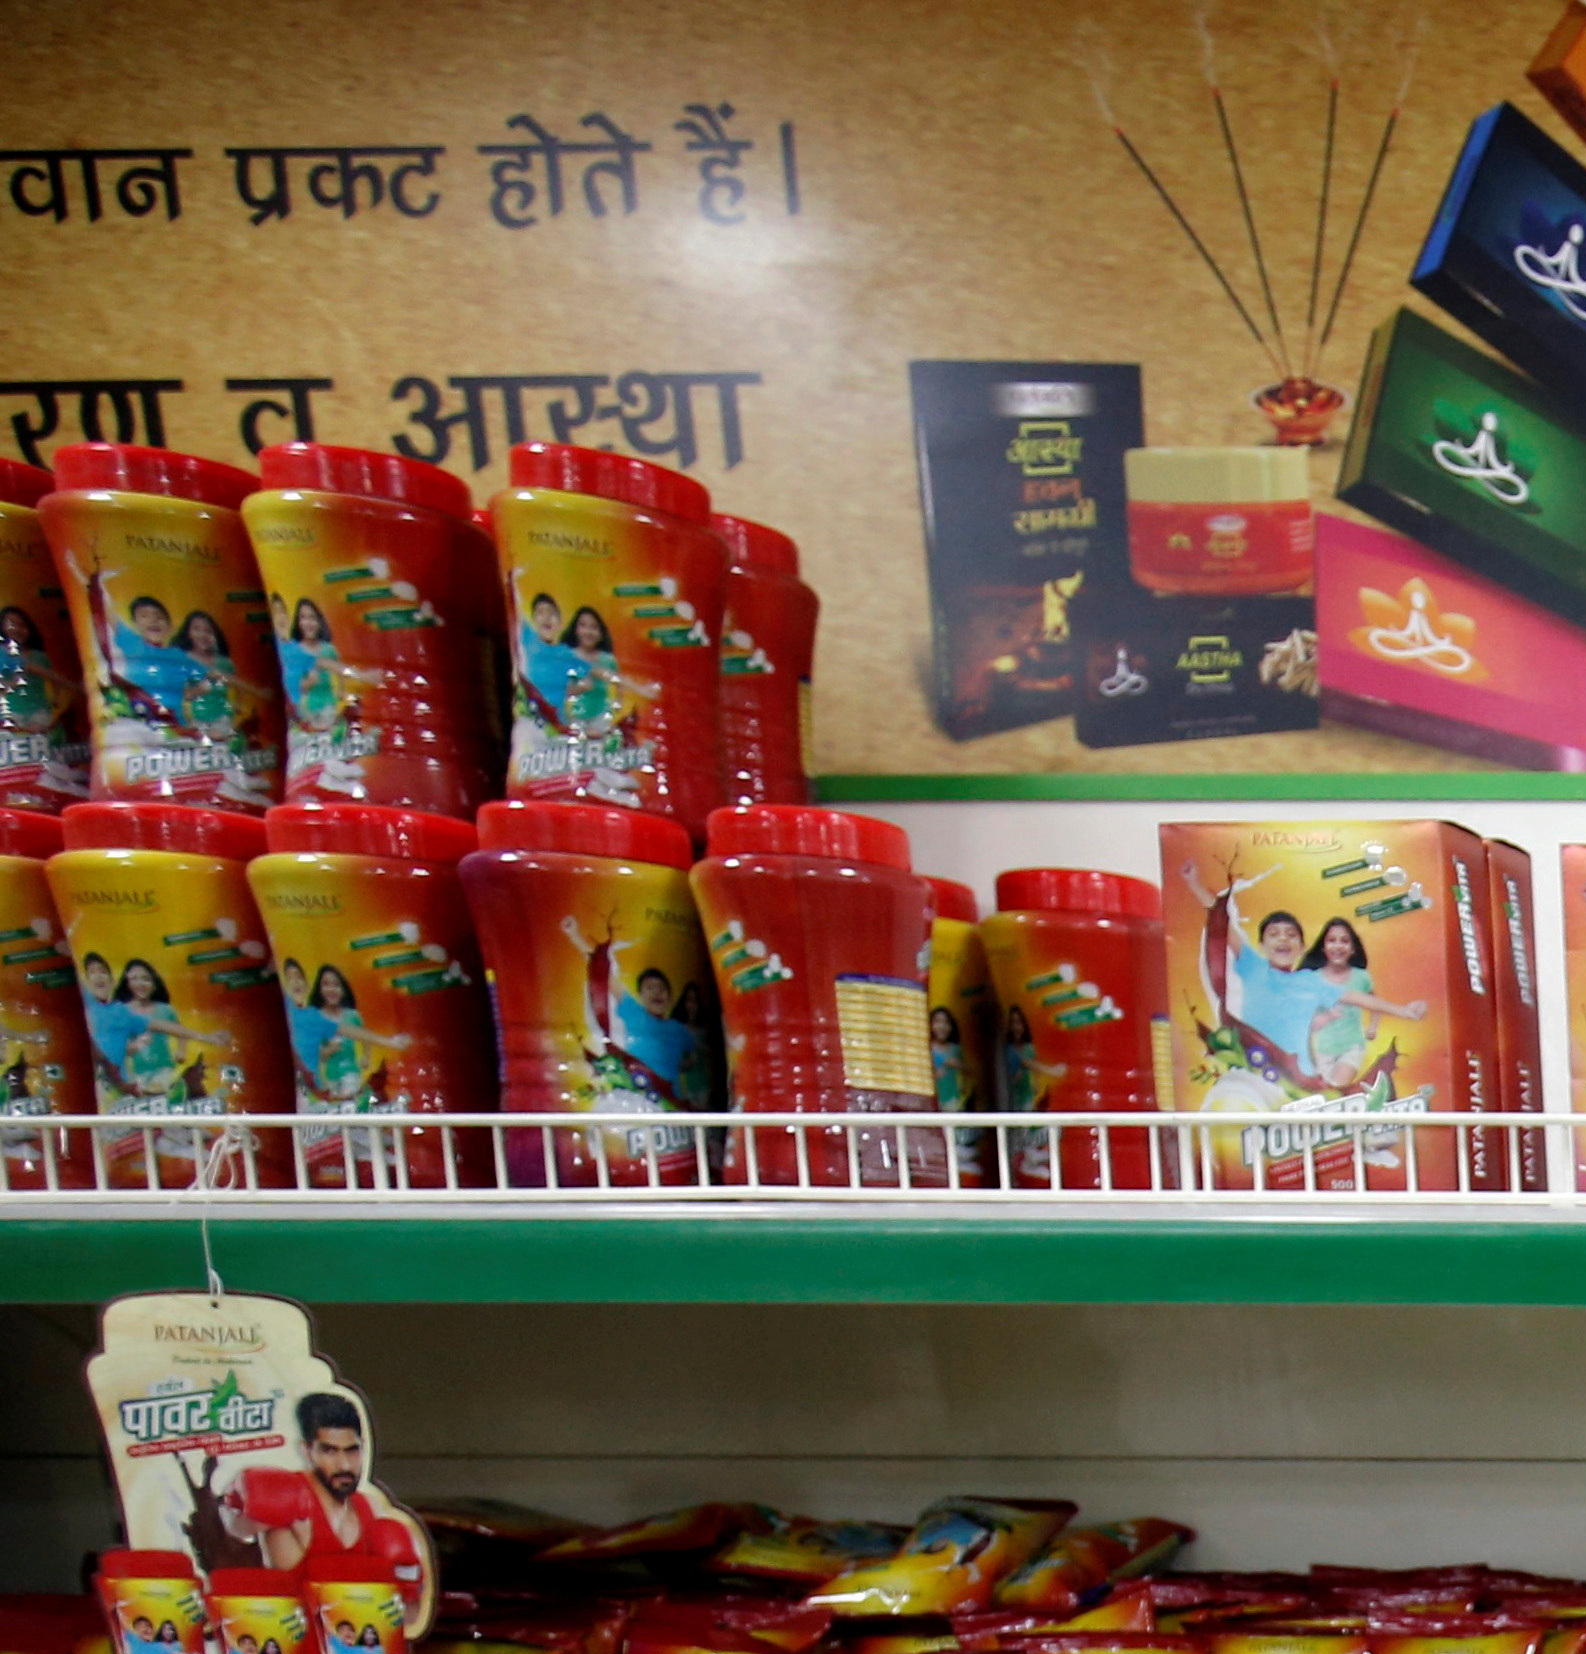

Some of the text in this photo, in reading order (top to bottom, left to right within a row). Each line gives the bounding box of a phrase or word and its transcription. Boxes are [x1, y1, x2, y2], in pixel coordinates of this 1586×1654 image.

[225, 146, 444, 226] प्रकट
[478, 112, 651, 229] होते
[390, 370, 760, 472] आस्था
[1177, 648, 1243, 672] AASTHA
[127, 743, 228, 781] POWER
[155, 1324, 257, 1345] PATANJALI
[120, 1393, 273, 1436] पावर वीटा
